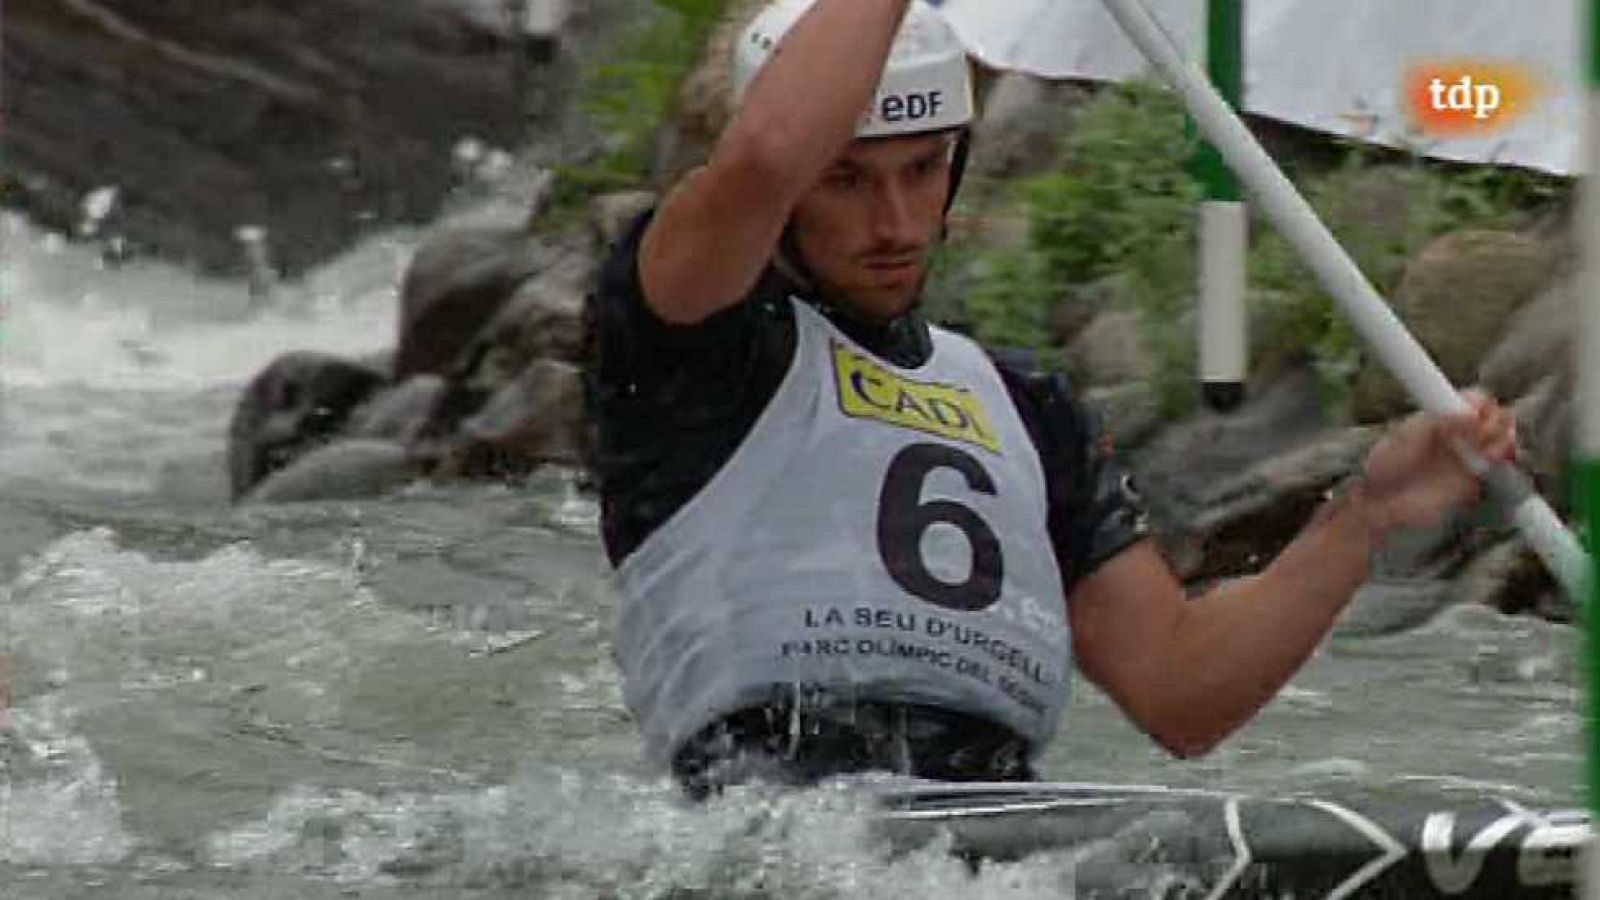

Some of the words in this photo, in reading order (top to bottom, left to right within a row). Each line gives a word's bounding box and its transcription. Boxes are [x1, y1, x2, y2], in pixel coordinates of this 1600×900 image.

[876, 442, 1004, 612] 6
[804, 607, 844, 628] LA
[854, 607, 915, 632] SEU
[925, 616, 1048, 684] D'URGELL
[955, 659, 990, 684] DEL
